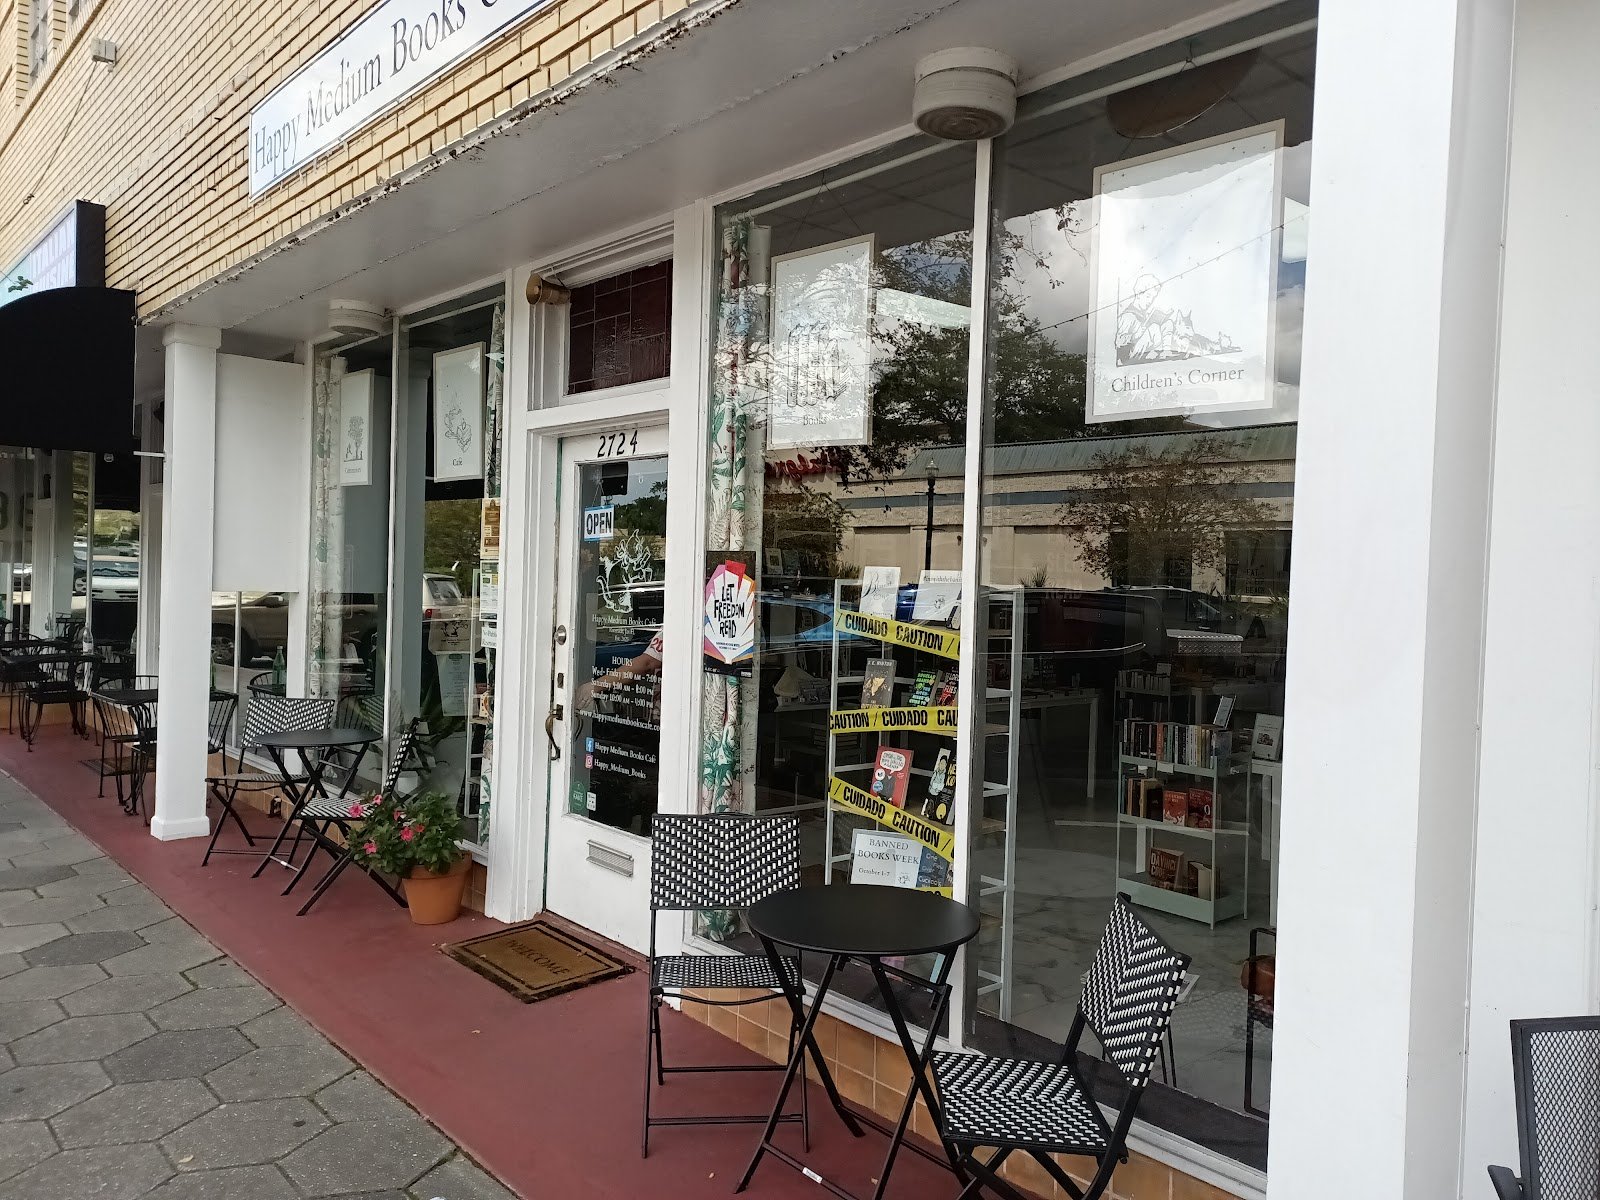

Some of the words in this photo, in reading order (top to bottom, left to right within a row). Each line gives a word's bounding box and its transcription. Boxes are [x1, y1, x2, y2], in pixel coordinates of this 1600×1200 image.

[254, 112, 301, 179] Happy
[305, 53, 382, 137] Medium
[389, 0, 466, 78] Books
[1111, 372, 1183, 393] Children's
[1188, 368, 1245, 385] Corner
[597, 430, 638, 458] 2724
[586, 511, 612, 535] OPEN
[722, 583, 735, 603] LET
[714, 599, 745, 622] FREEDOM
[719, 620, 737, 639] READ
[845, 614, 888, 637] CUIDADO
[895, 625, 943, 651] CAUTION
[611, 656, 633, 667] HOURS
[829, 712, 869, 730] CAUTION
[882, 709, 928, 726] CUIDADO
[937, 709, 958, 726] CAU
[594, 742, 610, 755] Happy
[843, 786, 886, 820] CUIDADO
[892, 811, 940, 848] CAUTION
[869, 837, 909, 851] BANNED
[857, 850, 890, 861] BOOKS
[891, 852, 920, 865] WEEK
[858, 867, 880, 877] October
[506, 939, 571, 976] WELCOME
